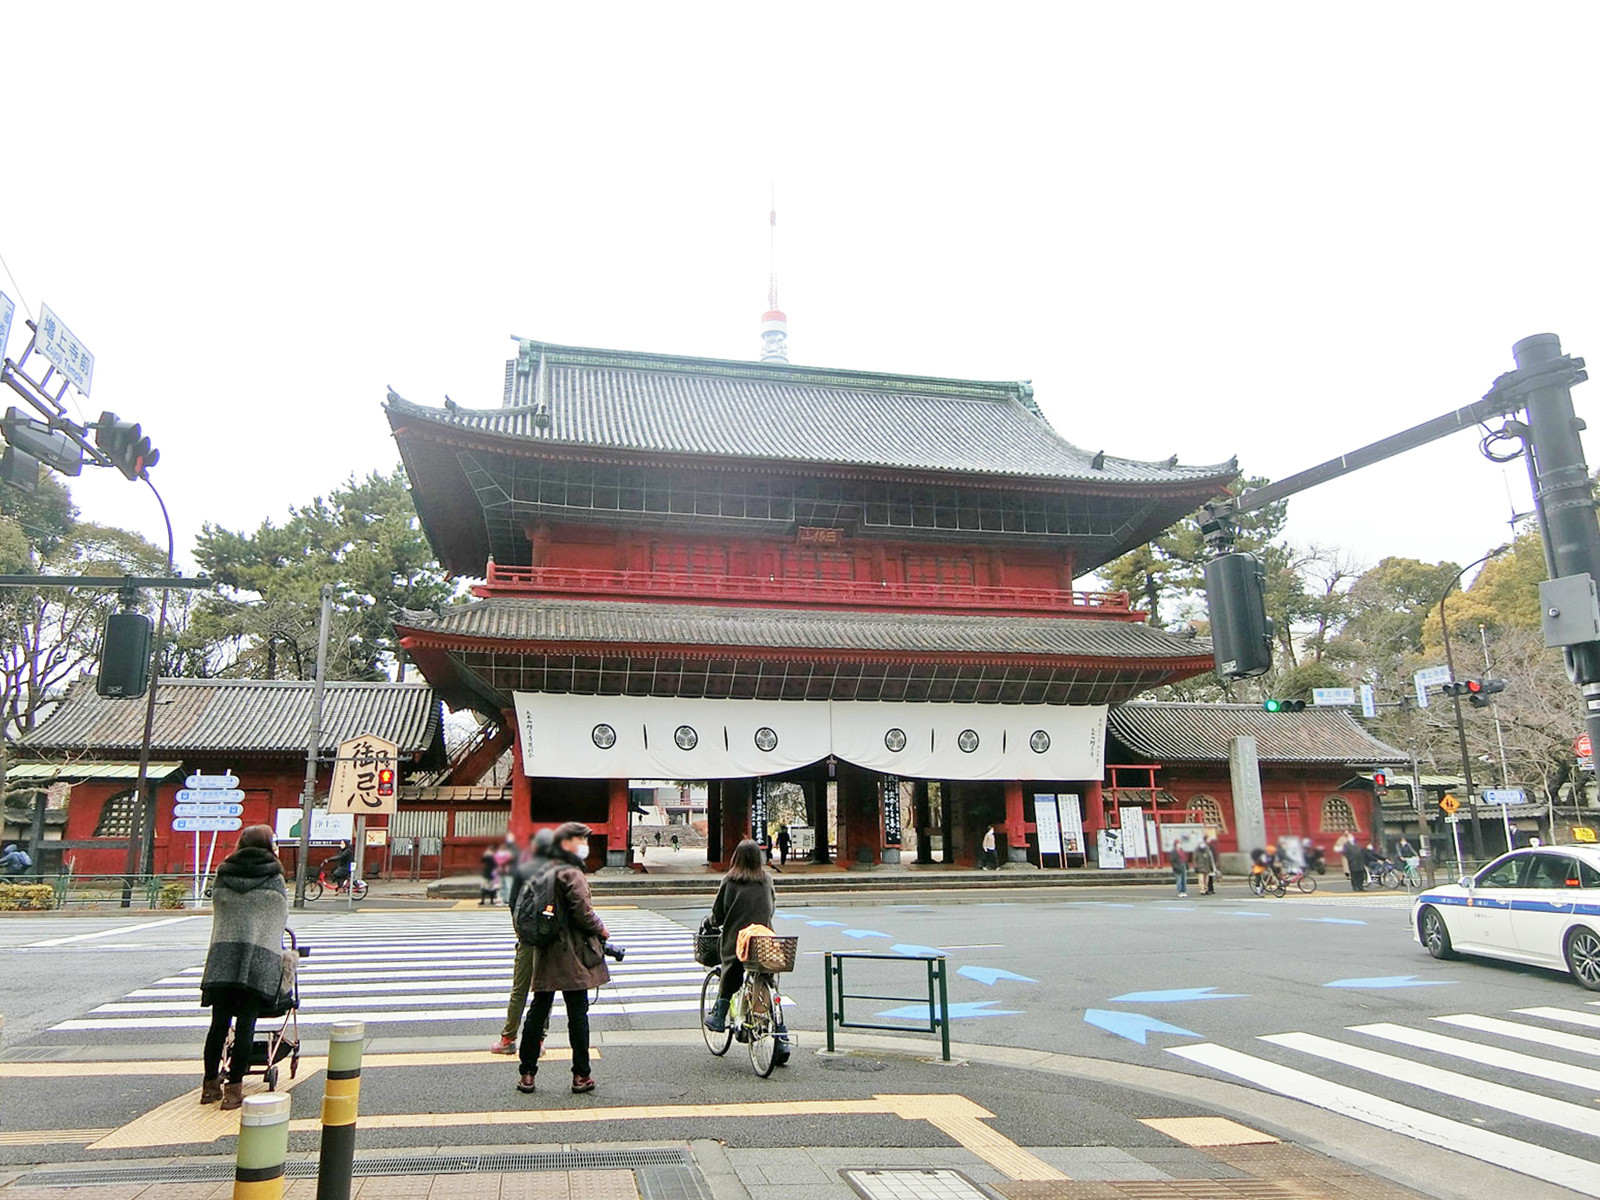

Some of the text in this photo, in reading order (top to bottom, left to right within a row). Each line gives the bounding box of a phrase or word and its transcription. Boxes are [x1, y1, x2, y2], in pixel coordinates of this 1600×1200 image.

[43, 314, 91, 376] 増上寺前
[346, 741, 389, 808] 御忌
